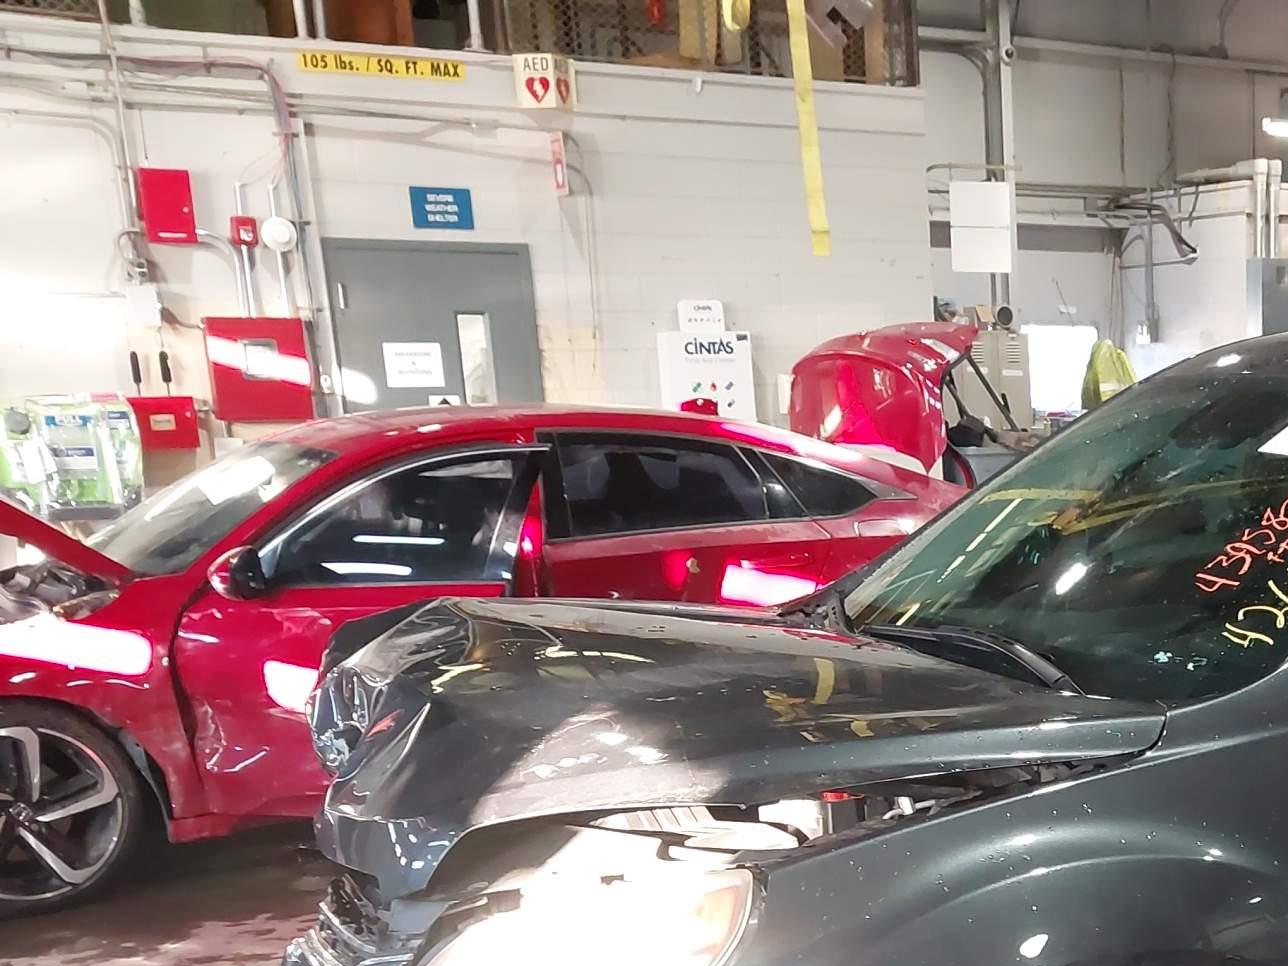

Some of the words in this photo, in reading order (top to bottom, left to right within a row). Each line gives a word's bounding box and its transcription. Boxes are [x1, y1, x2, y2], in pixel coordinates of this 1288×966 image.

[301, 54, 328, 69] 105
[334, 54, 360, 72] lbs.
[366, 56, 370, 73] /
[377, 58, 399, 74] SQ.
[405, 61, 425, 76] FT.
[430, 62, 460, 78] MAX
[523, 57, 549, 72] AED
[684, 337, 735, 355] CINTAS
